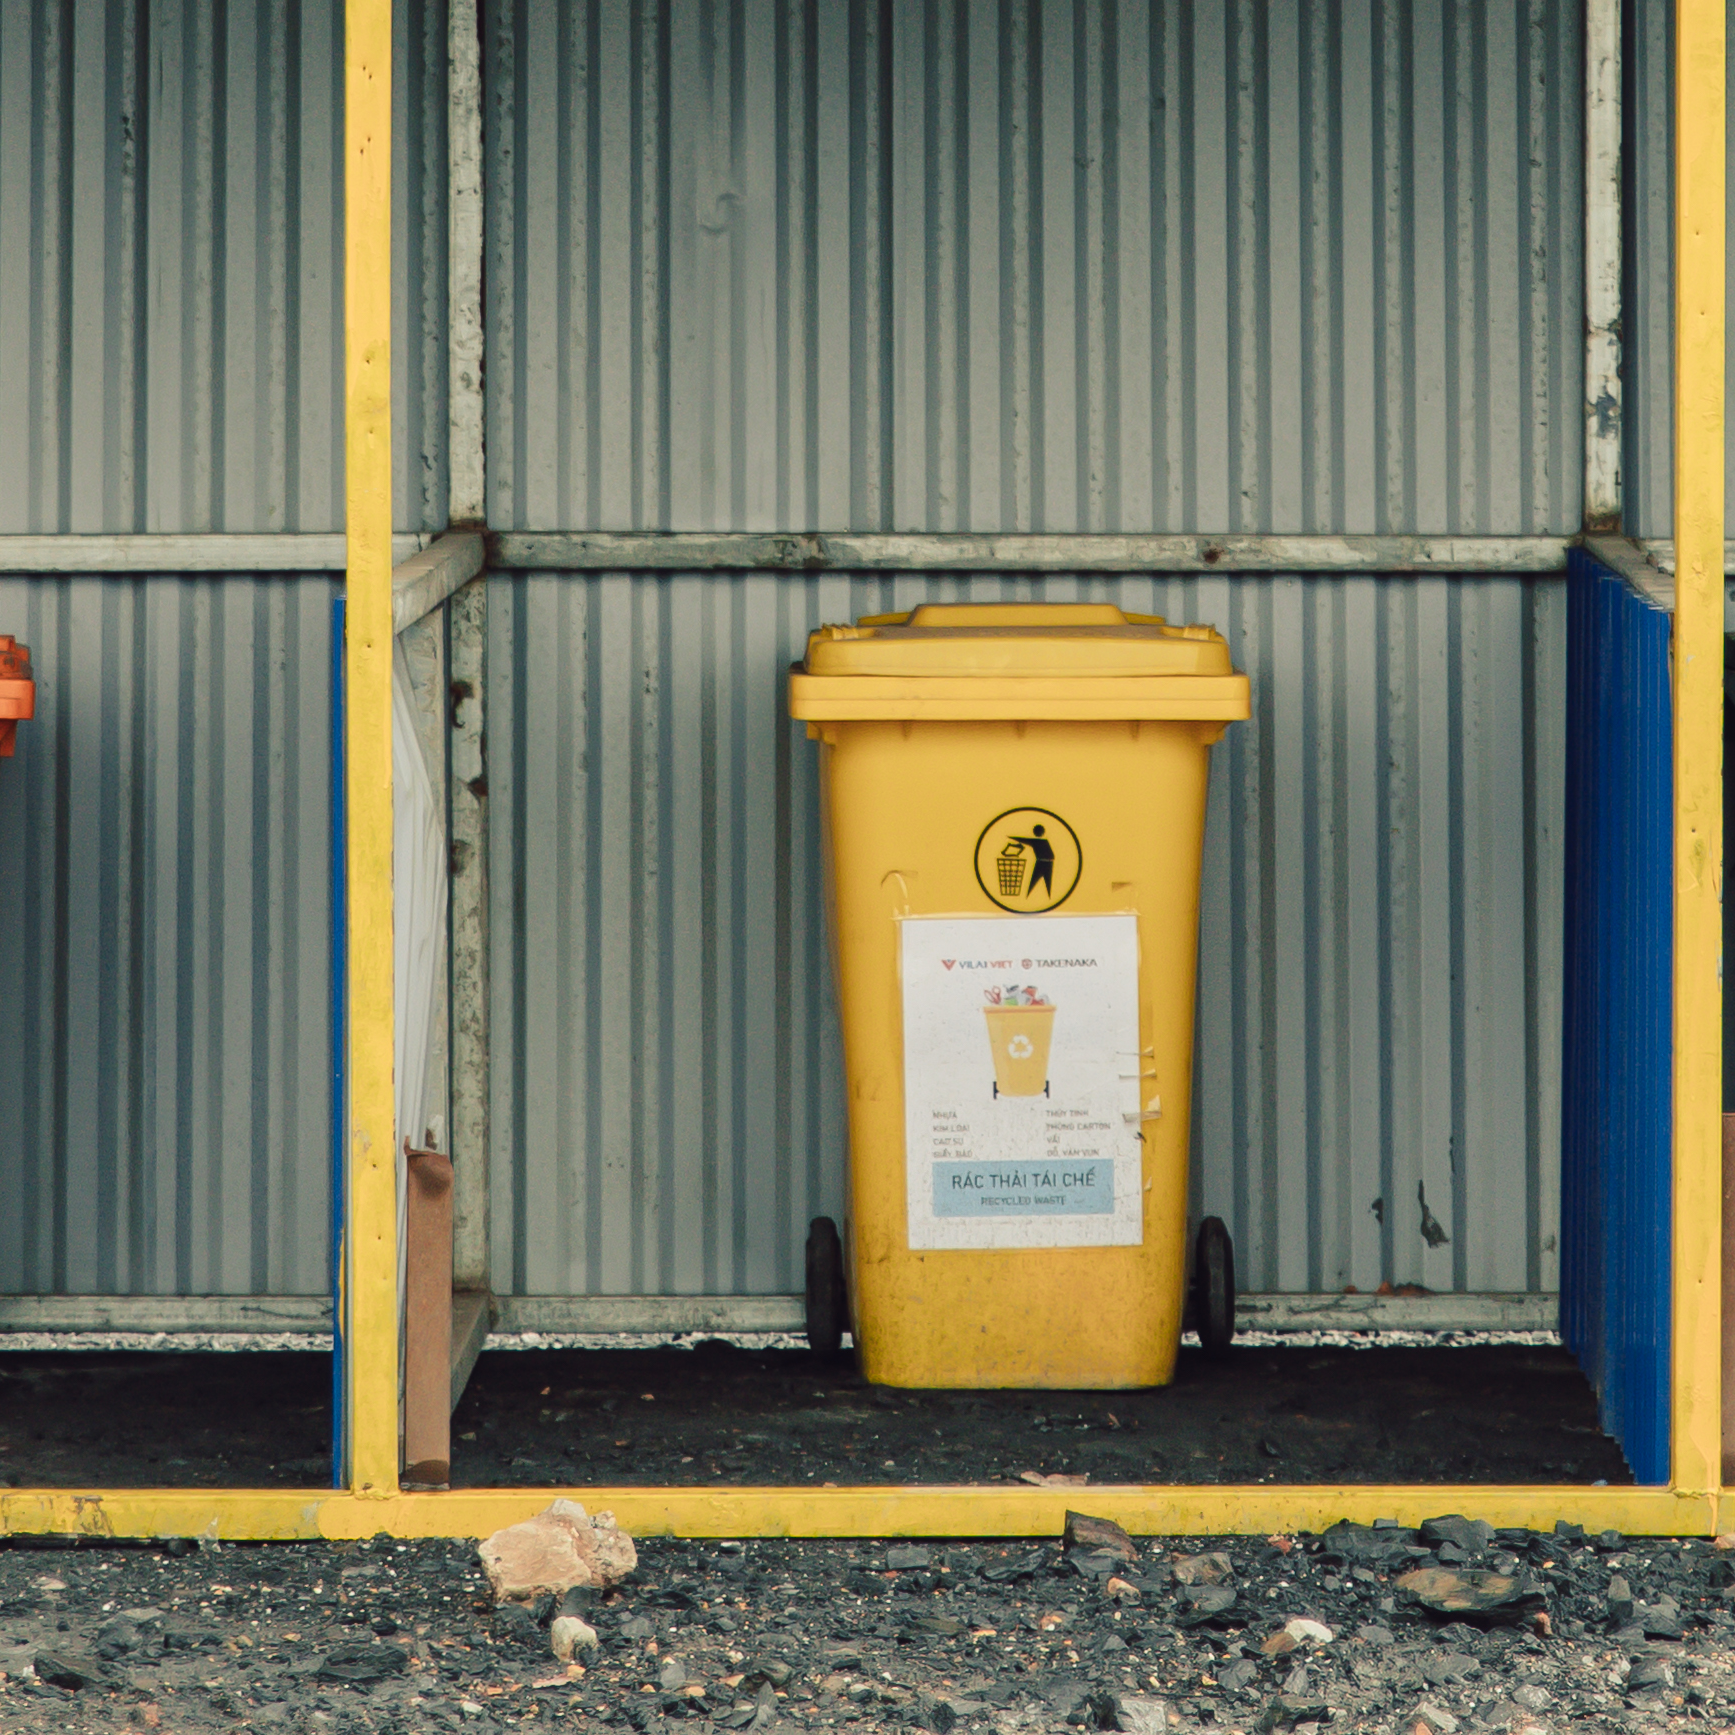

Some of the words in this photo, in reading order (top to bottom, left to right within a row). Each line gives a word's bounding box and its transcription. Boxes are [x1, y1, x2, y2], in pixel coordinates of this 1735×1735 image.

[1035, 958, 1098, 968] TAKENAKA
[952, 1170, 984, 1189] RÁC
[989, 1169, 1027, 1188] THẢI
[1032, 1169, 1057, 1187] TÁI
[1062, 1166, 1096, 1187] CHẾ
[981, 1196, 1031, 1206] RECYCLED
[1034, 1195, 1066, 1205] WASTE
